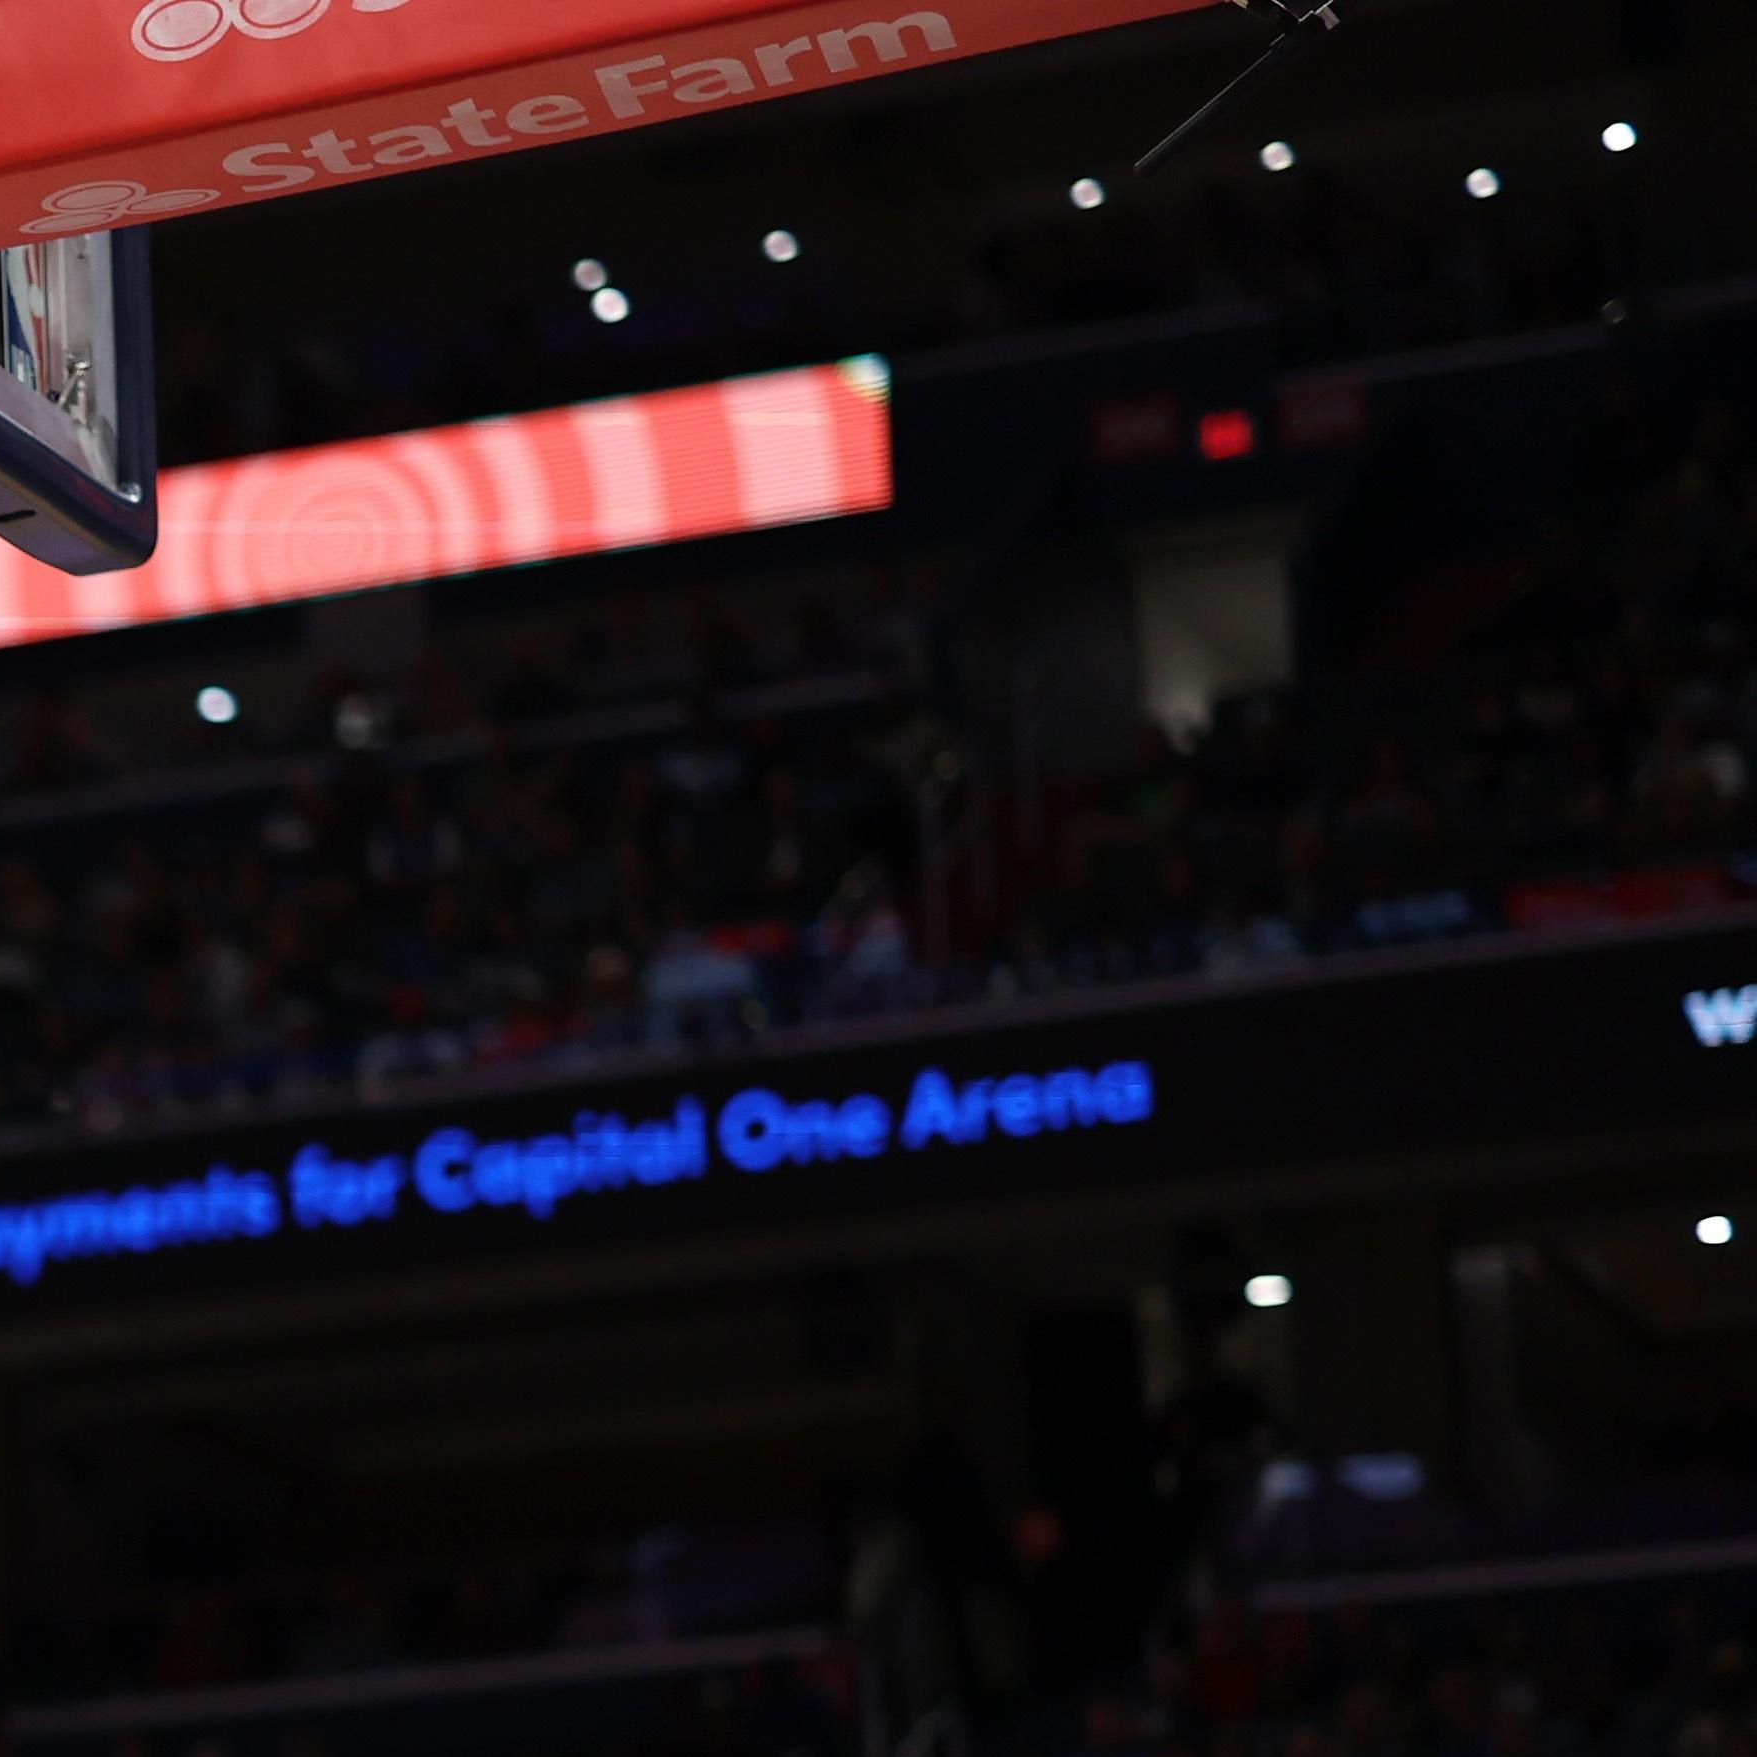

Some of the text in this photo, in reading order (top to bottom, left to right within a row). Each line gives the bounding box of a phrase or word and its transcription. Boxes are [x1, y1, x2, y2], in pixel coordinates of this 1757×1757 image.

[222, 9, 959, 193] State Farm
[289, 1141, 405, 1227] for
[413, 1092, 706, 1218] Capital
[716, 1087, 889, 1172] One
[901, 1059, 1153, 1150] Arena
